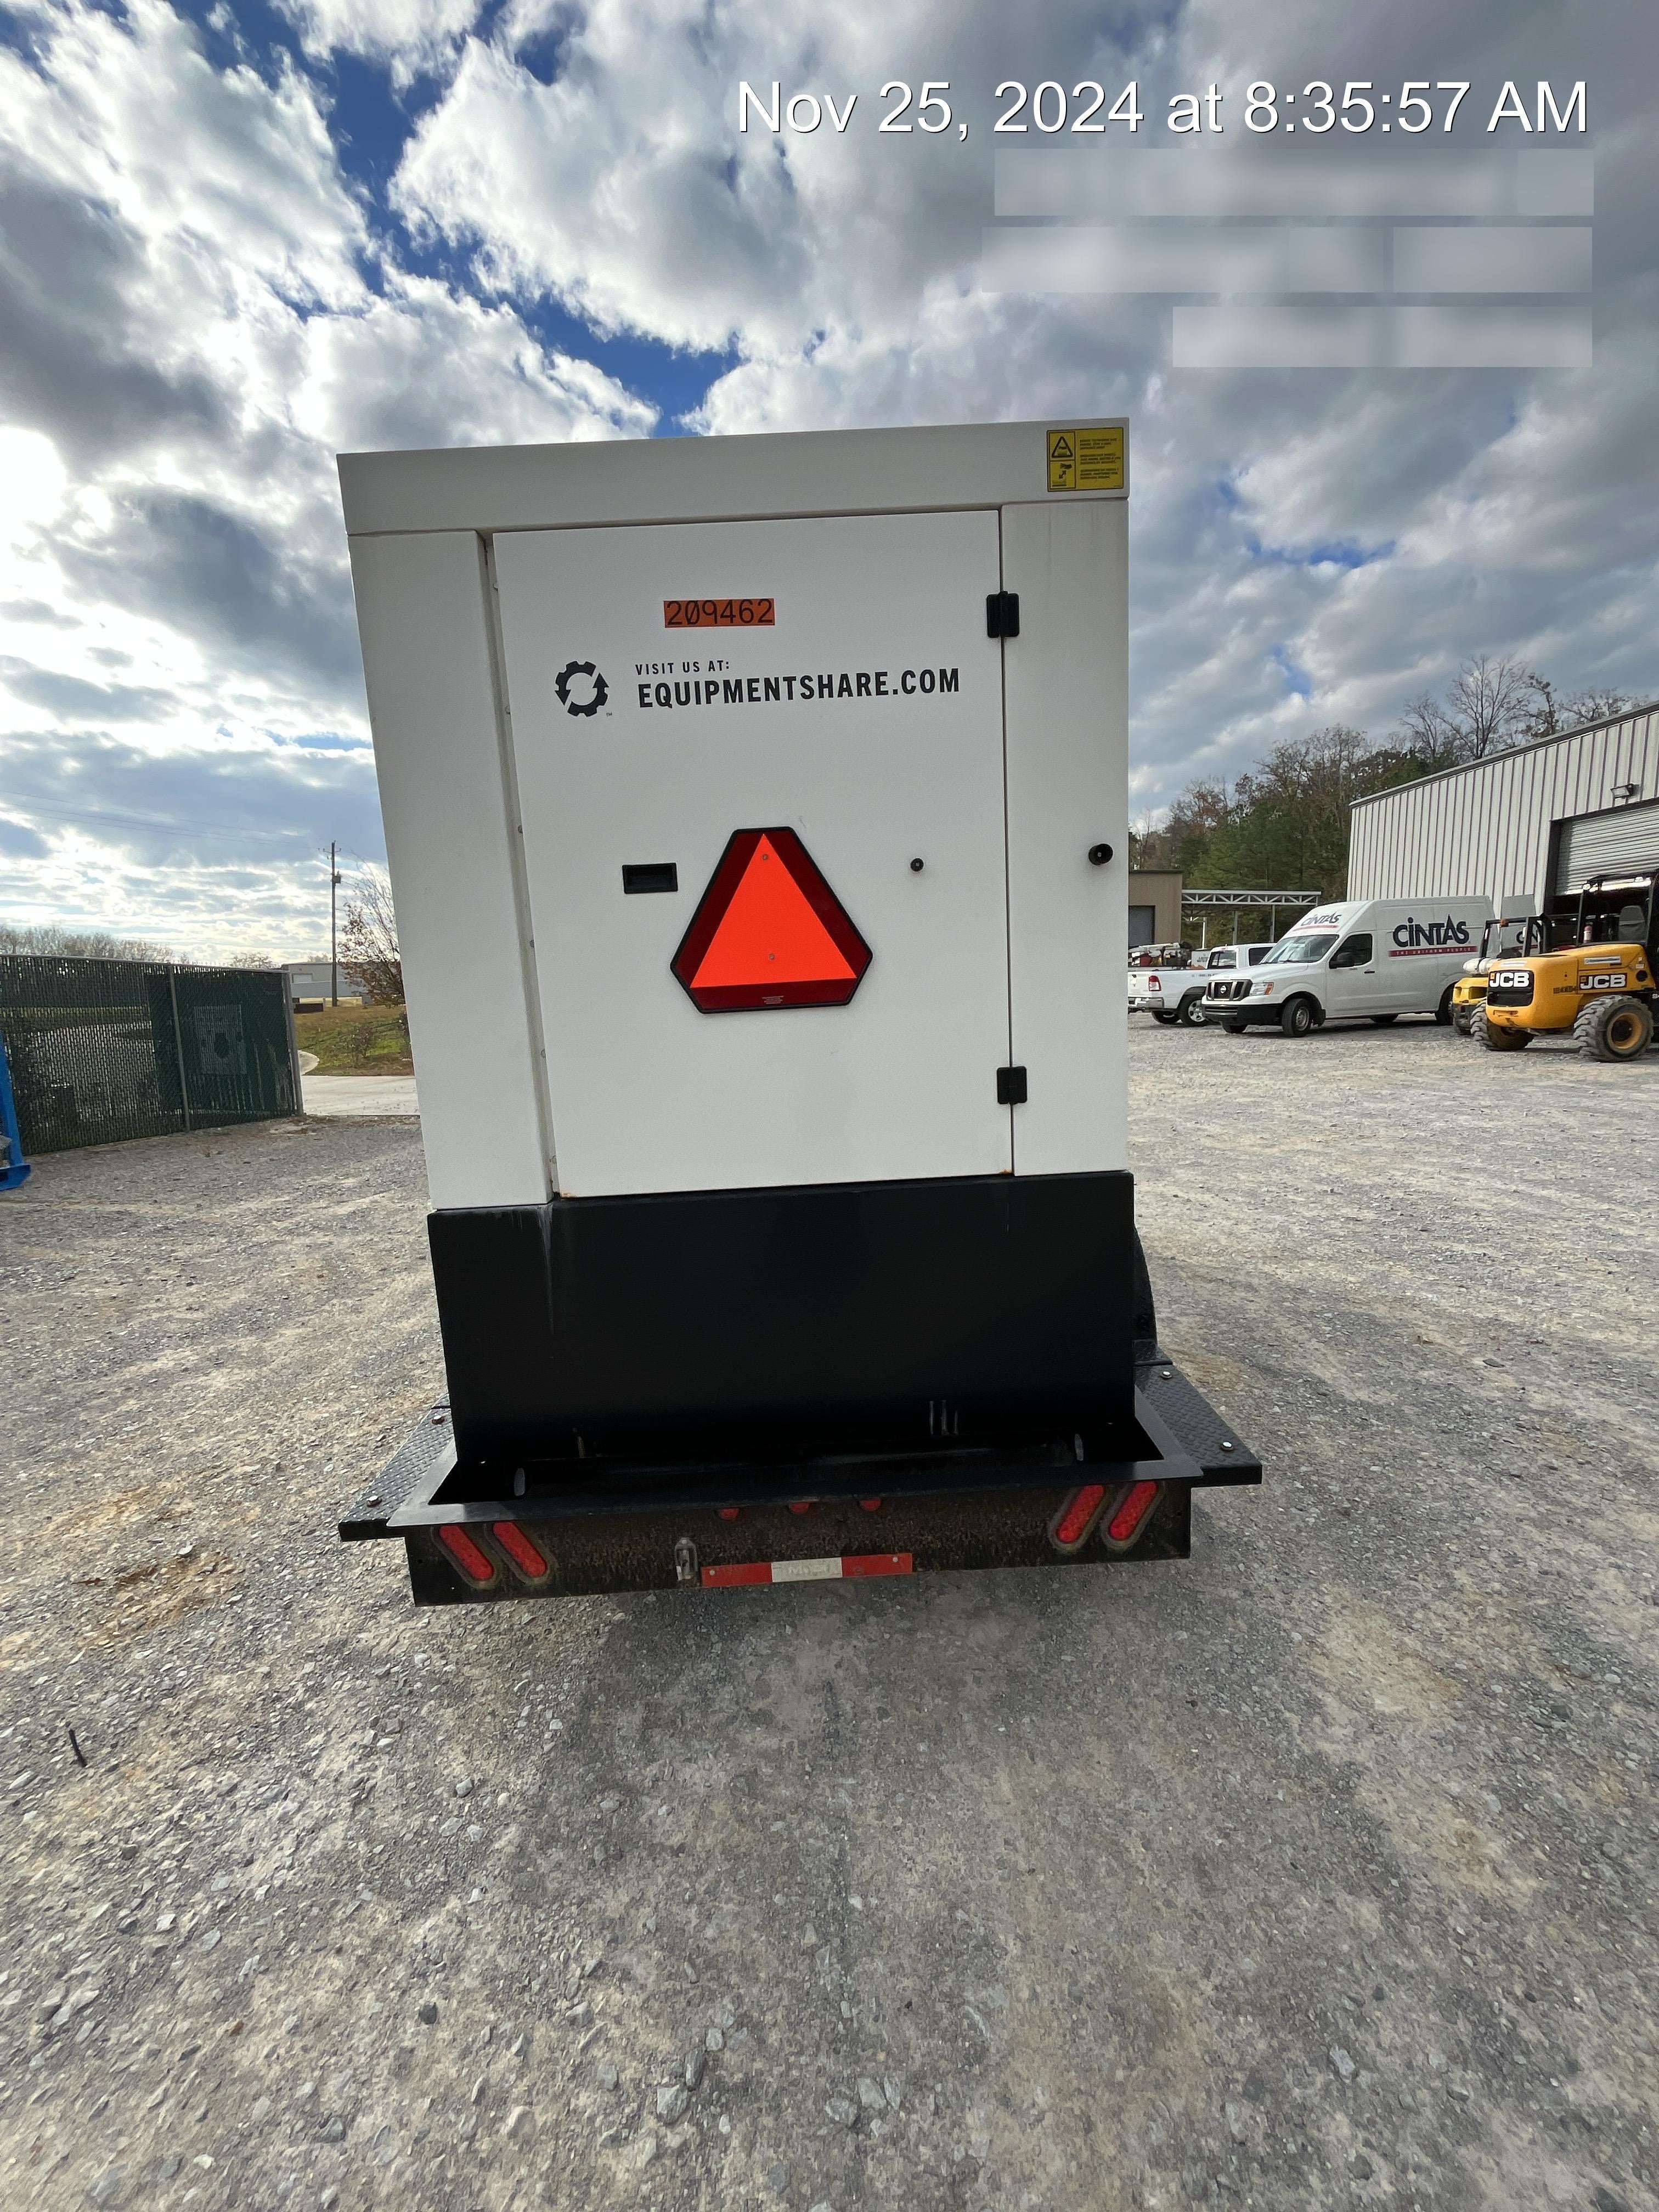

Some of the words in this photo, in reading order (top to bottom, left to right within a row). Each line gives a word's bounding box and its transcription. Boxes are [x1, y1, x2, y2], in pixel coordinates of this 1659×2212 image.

[667, 599, 773, 625] 209462
[635, 662, 674, 675] VISIT
[682, 661, 700, 673] US
[708, 660, 729, 672] AT:
[638, 668, 959, 709] EQUIPMENTSHARE.COM
[1489, 972, 1530, 988] JCB
[1580, 974, 1626, 989] JCB
